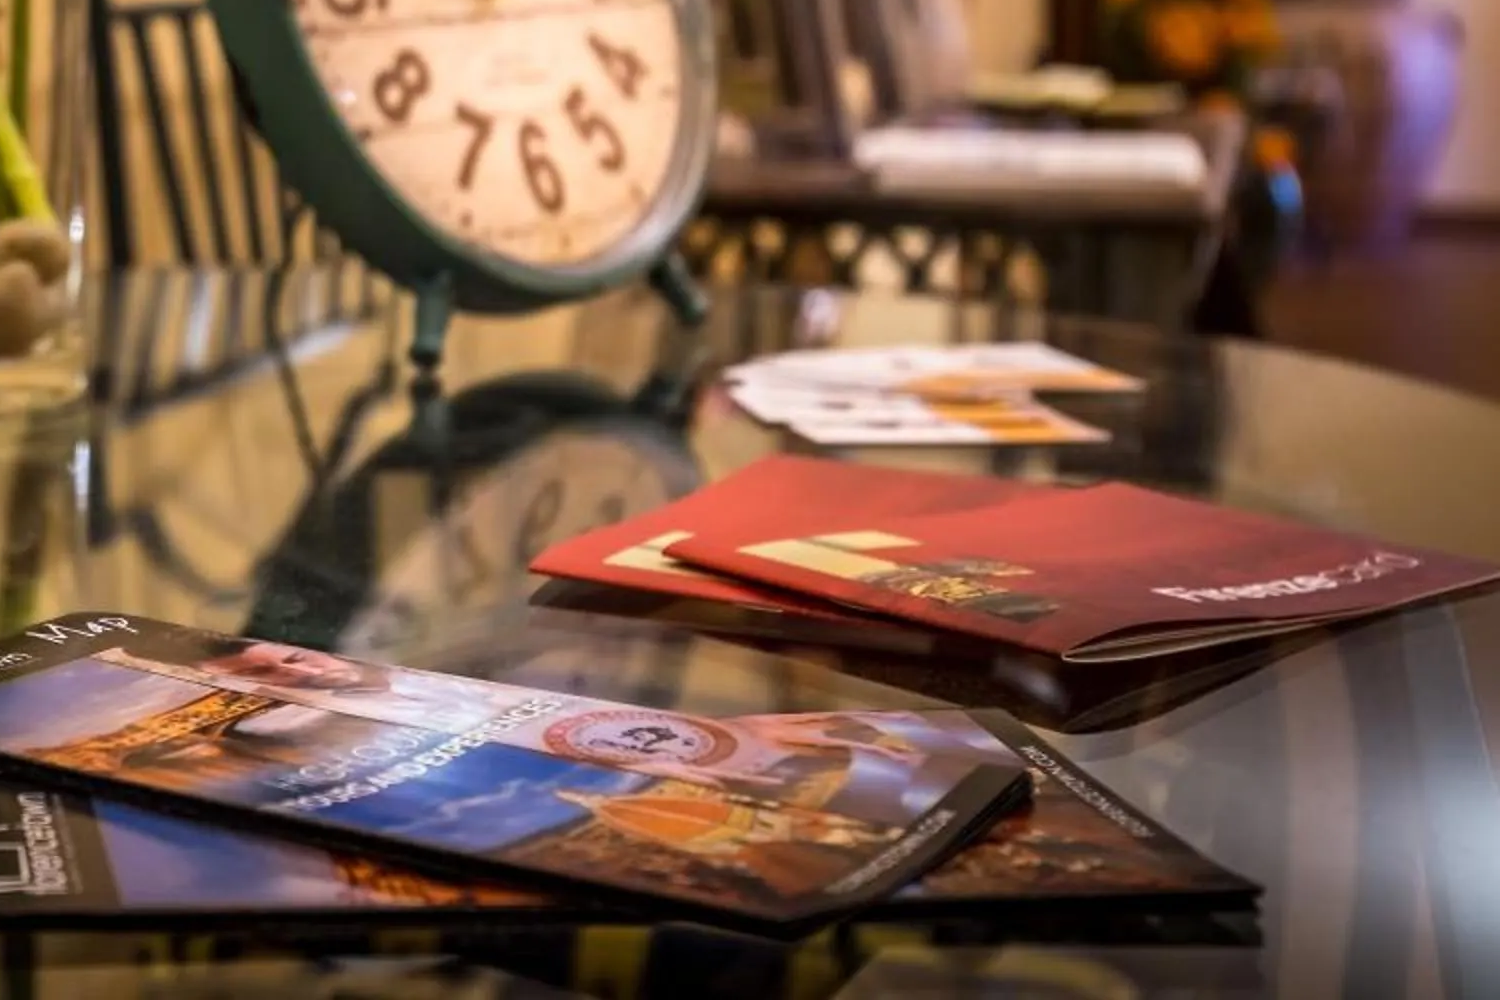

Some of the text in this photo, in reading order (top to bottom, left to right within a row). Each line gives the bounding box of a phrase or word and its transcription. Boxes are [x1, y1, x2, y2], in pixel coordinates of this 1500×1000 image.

[372, 48, 431, 122] 8
[587, 31, 650, 101] 4
[454, 101, 495, 191] 7
[518, 121, 565, 214] 6
[565, 85, 625, 173] 5
